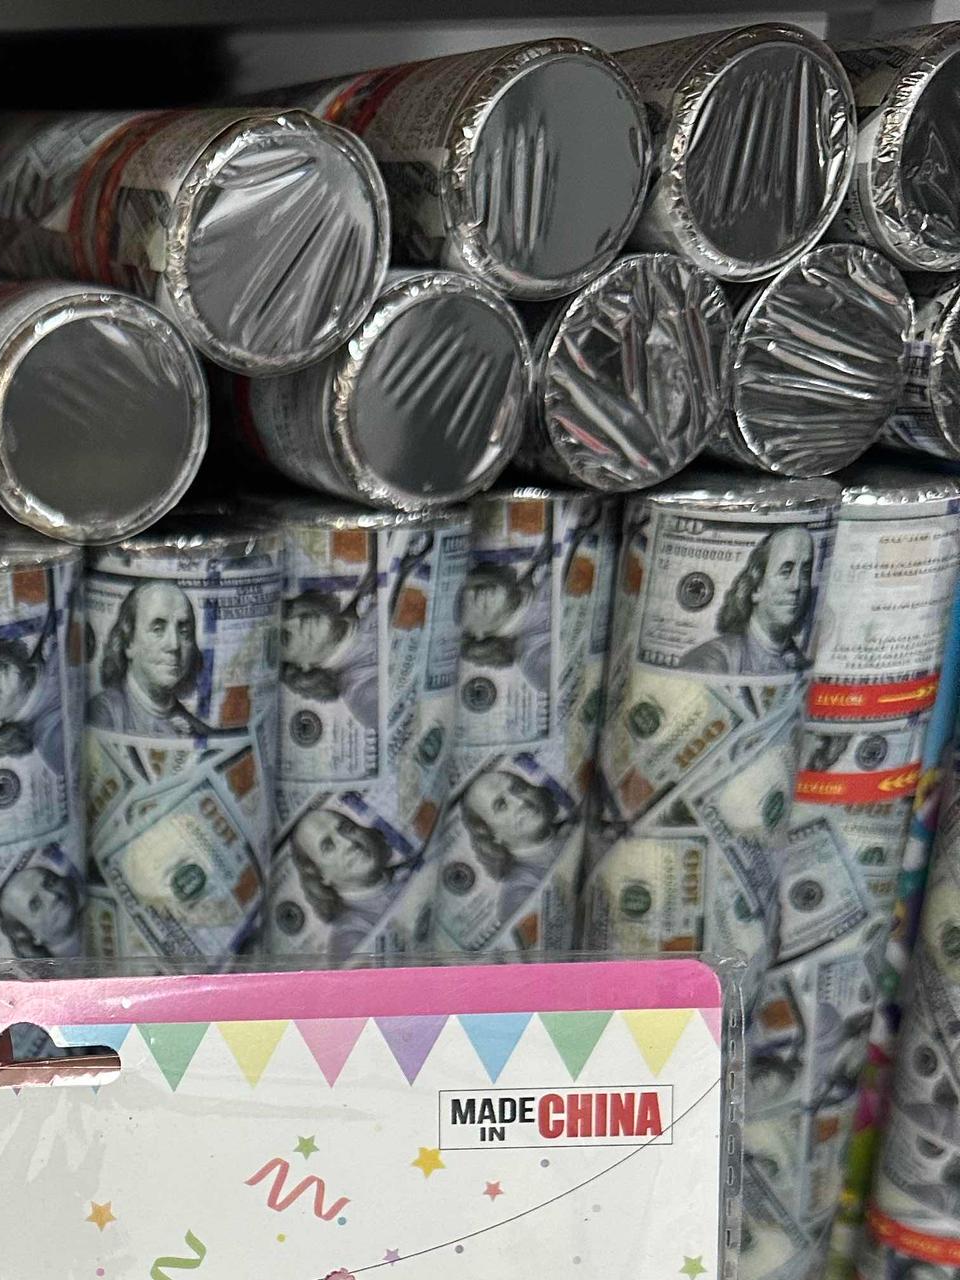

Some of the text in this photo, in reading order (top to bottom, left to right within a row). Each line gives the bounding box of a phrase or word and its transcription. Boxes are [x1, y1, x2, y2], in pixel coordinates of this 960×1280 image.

[451, 1092, 663, 1142] MADE IN CHINA
